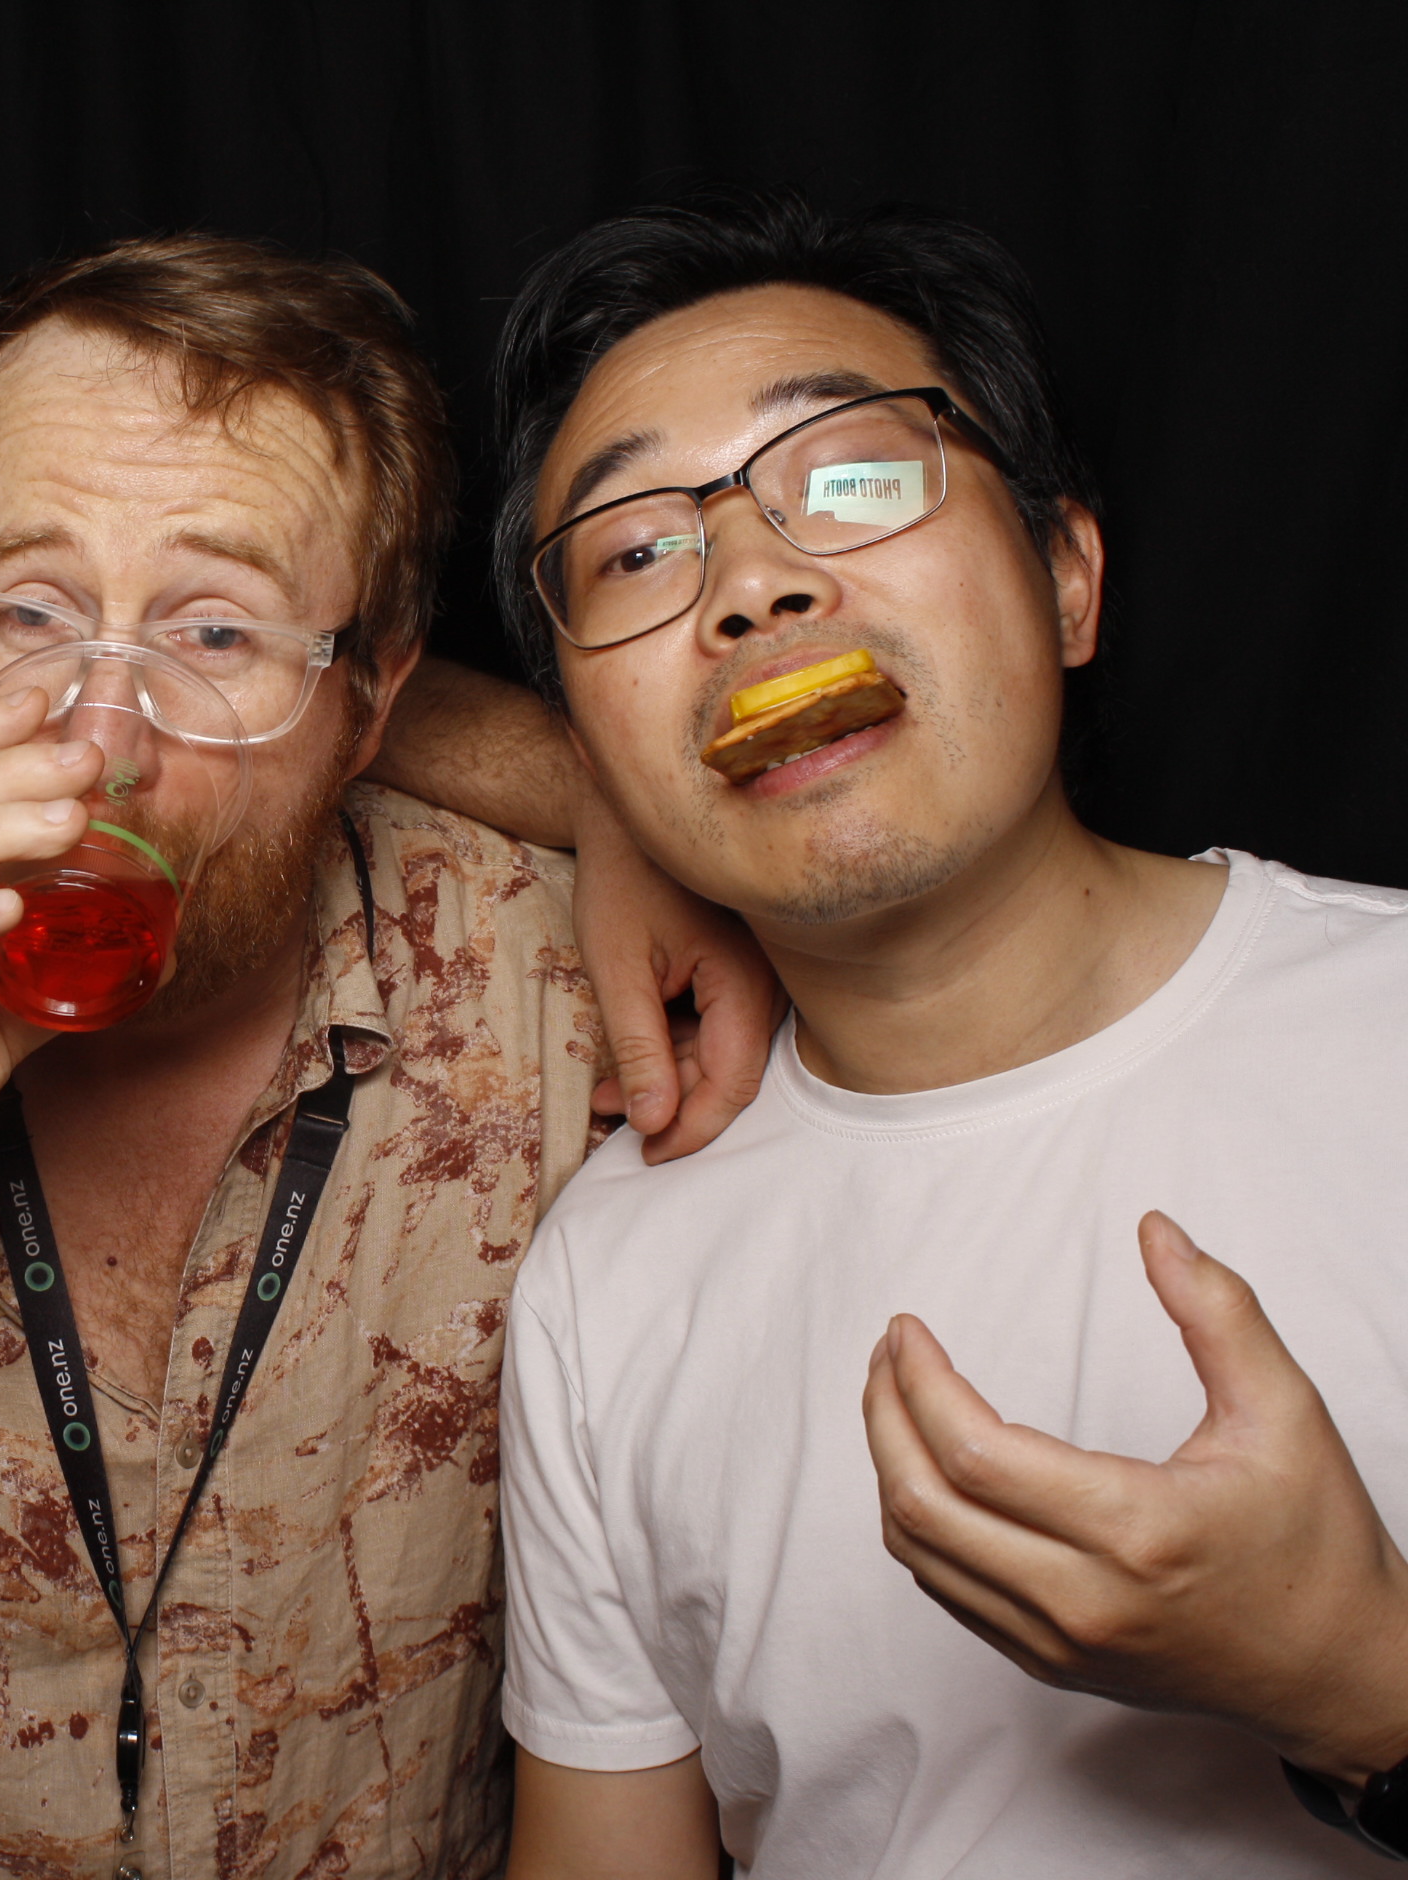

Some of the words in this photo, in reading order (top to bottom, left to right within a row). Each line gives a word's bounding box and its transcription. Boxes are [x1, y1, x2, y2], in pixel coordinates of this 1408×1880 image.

[9, 1179, 40, 1257] one.nz
[271, 1190, 305, 1267] one.nz
[48, 1338, 78, 1417] one.nz
[221, 1348, 253, 1423] one.nz
[88, 1498, 115, 1574] one.nz
